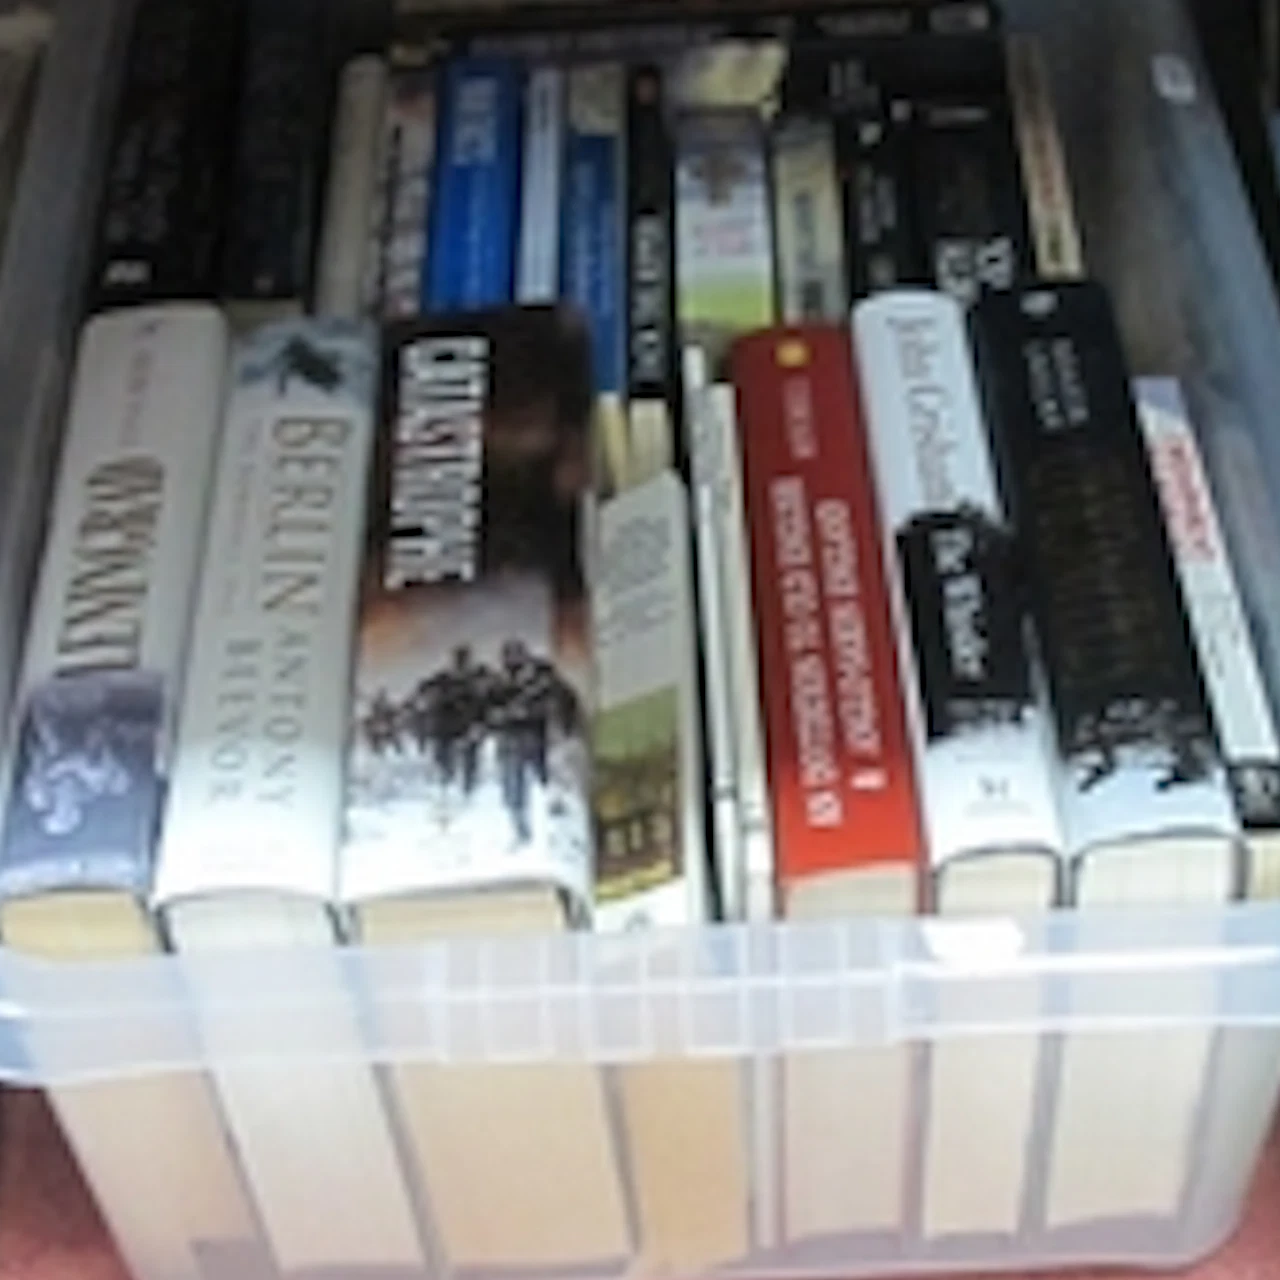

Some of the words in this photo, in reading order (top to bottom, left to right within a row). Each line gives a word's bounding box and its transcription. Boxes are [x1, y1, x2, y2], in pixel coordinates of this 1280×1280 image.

[885, 316, 946, 377] John
[261, 415, 351, 613] BERLIN
[383, 333, 490, 591] CATASTROPHE
[924, 528, 980, 574] The
[256, 631, 314, 808] ANTONY
